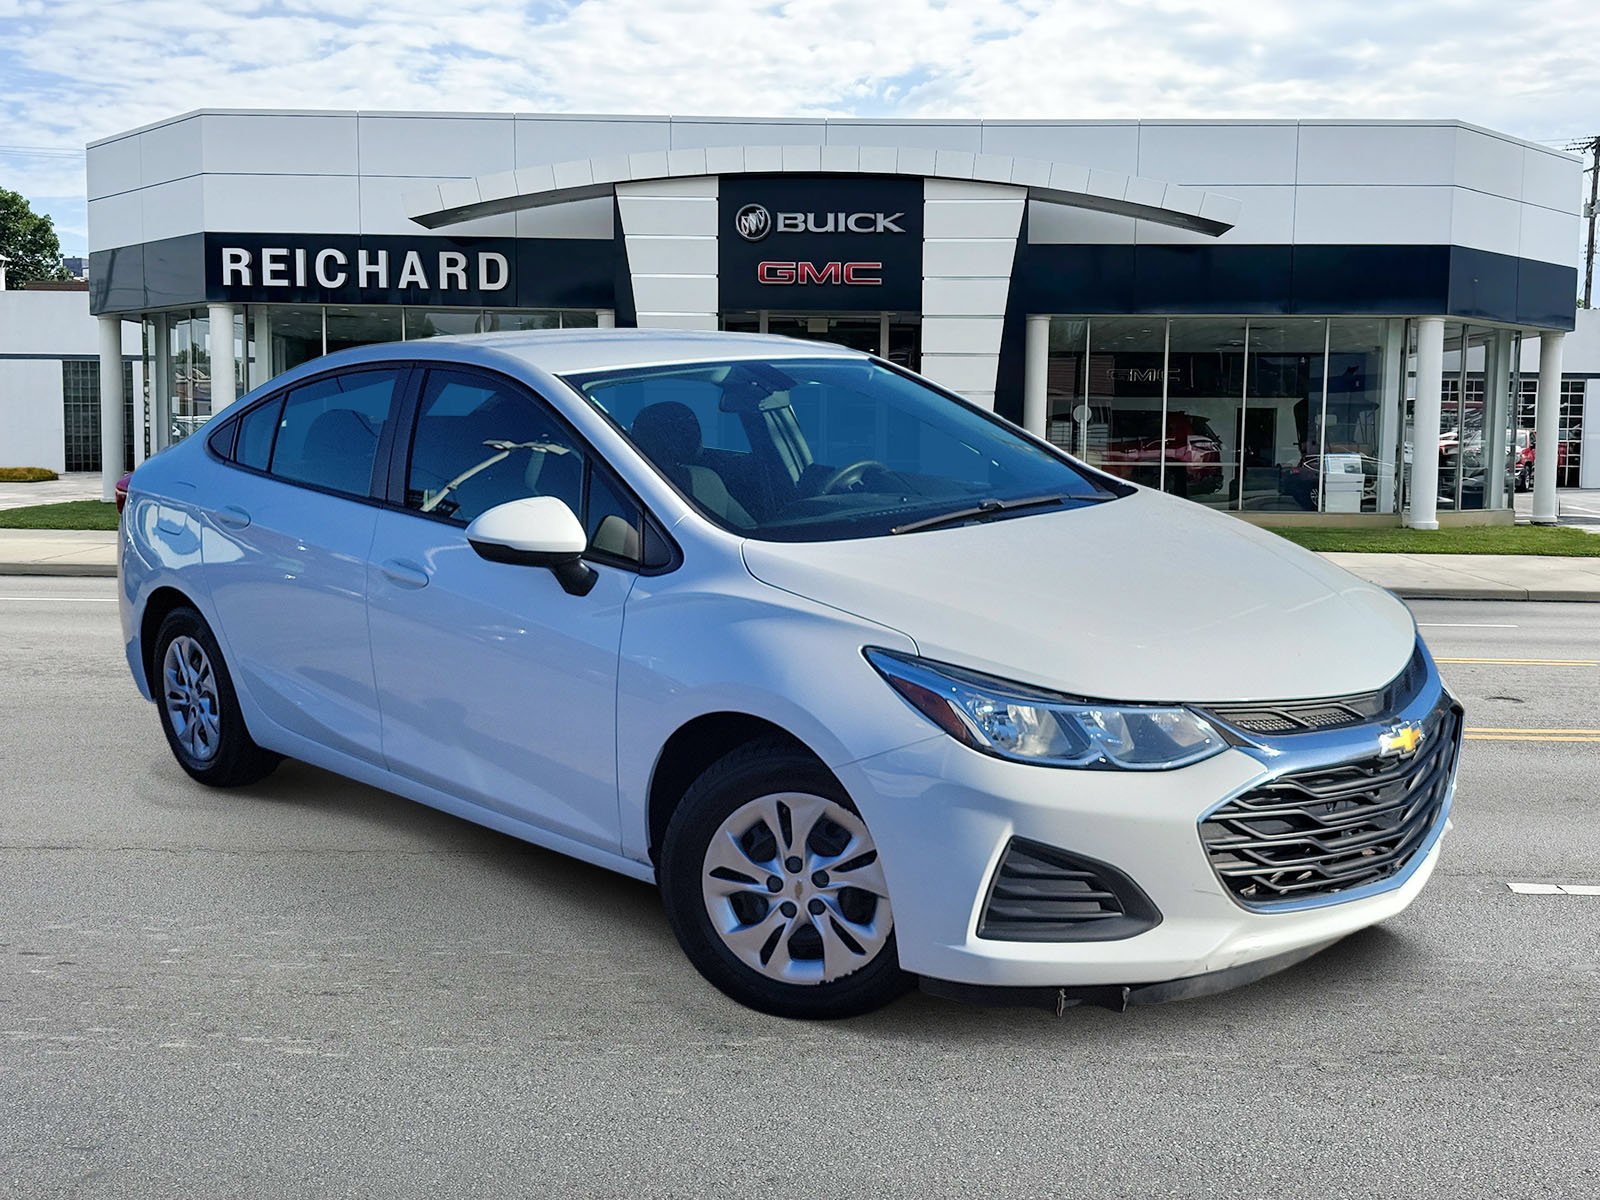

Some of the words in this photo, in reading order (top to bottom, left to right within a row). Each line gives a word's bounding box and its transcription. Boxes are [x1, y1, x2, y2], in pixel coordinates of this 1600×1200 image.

[776, 212, 907, 233] BUICK
[221, 247, 509, 291] REICHARD
[758, 261, 882, 285] GMC
[1106, 368, 1181, 382] GMC
